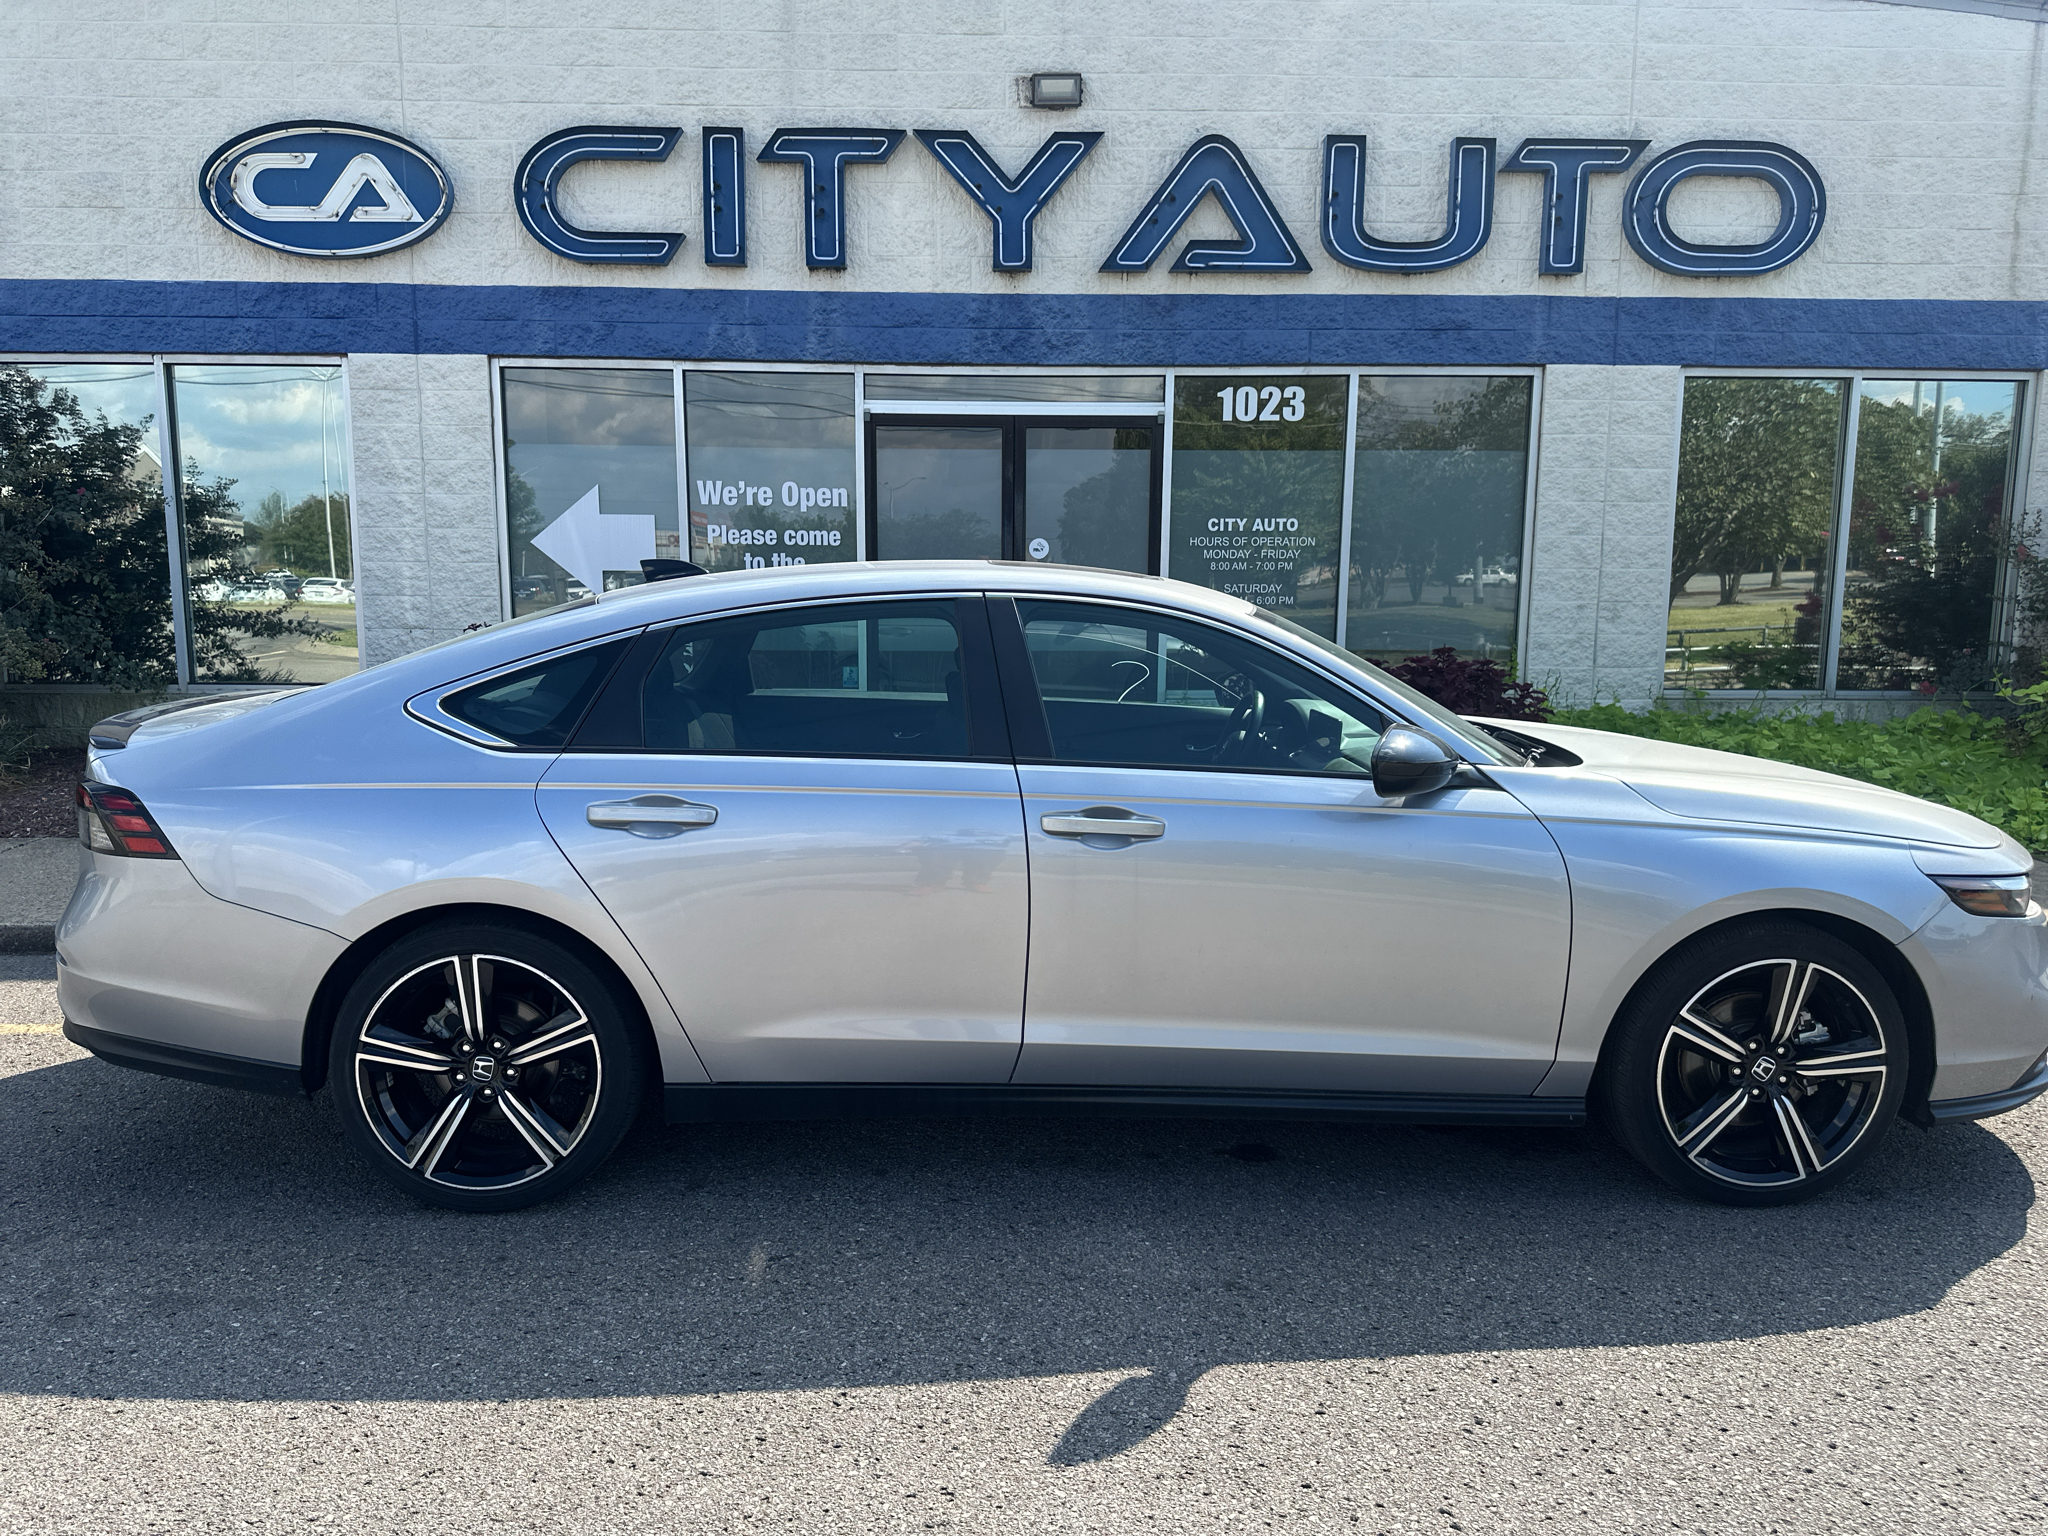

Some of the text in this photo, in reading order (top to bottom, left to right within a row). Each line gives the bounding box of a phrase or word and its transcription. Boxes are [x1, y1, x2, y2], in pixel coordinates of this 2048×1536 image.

[231, 152, 424, 222] CA
[515, 126, 1827, 276] CITY AUTO
[1217, 386, 1306, 422] 1023
[697, 480, 847, 512] We’re Open
[1207, 518, 1298, 531] CITY AUTO
[707, 524, 840, 546] Please come
[1190, 537, 1315, 546] HOURS OF OPERATION
[744, 553, 805, 570] to the
[1204, 549, 1251, 559] MONDAY
[1261, 550, 1301, 559] FRIDAY
[1210, 562, 1230, 570] 8:00
[1232, 562, 1247, 570] AM
[1256, 562, 1276, 570] 7:00
[1278, 562, 1293, 570] PM
[1224, 584, 1282, 593] SATURDAY
[1257, 596, 1276, 604] 6:00
[1279, 596, 1293, 604] PM
